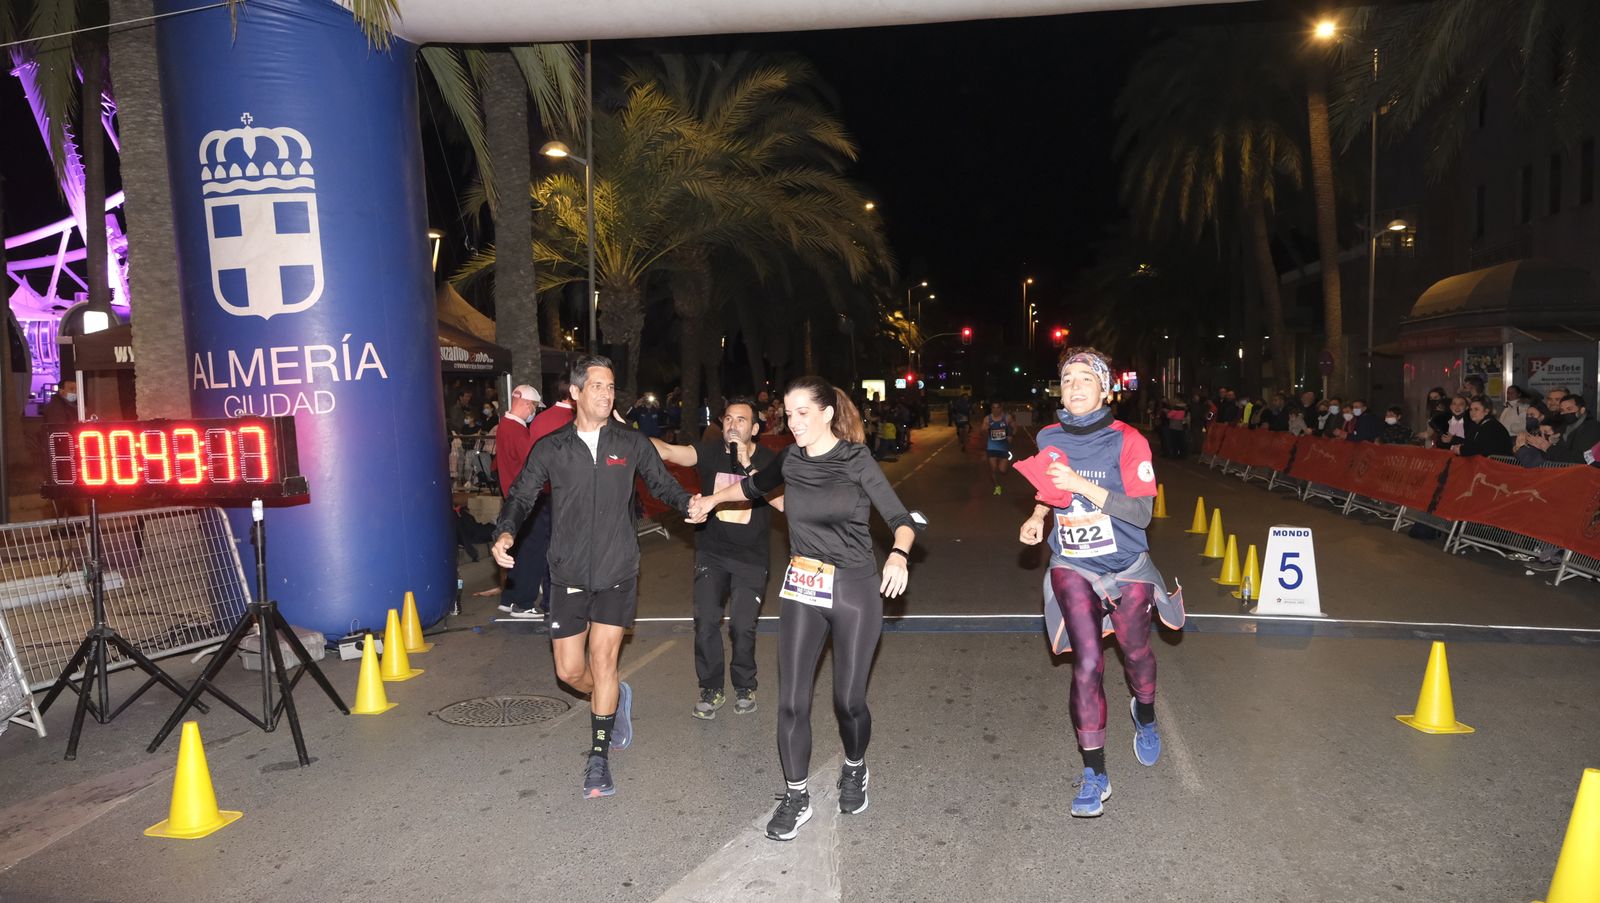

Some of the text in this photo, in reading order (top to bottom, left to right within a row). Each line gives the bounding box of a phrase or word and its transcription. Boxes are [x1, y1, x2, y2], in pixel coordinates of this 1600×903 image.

[193, 333, 388, 390] ALMERÍA
[224, 390, 336, 418] CIUDAD
[78, 426, 269, 485] 00:43:17
[1066, 526, 1103, 544] 122
[791, 570, 824, 589] 3401
[1278, 552, 1303, 590] 5
